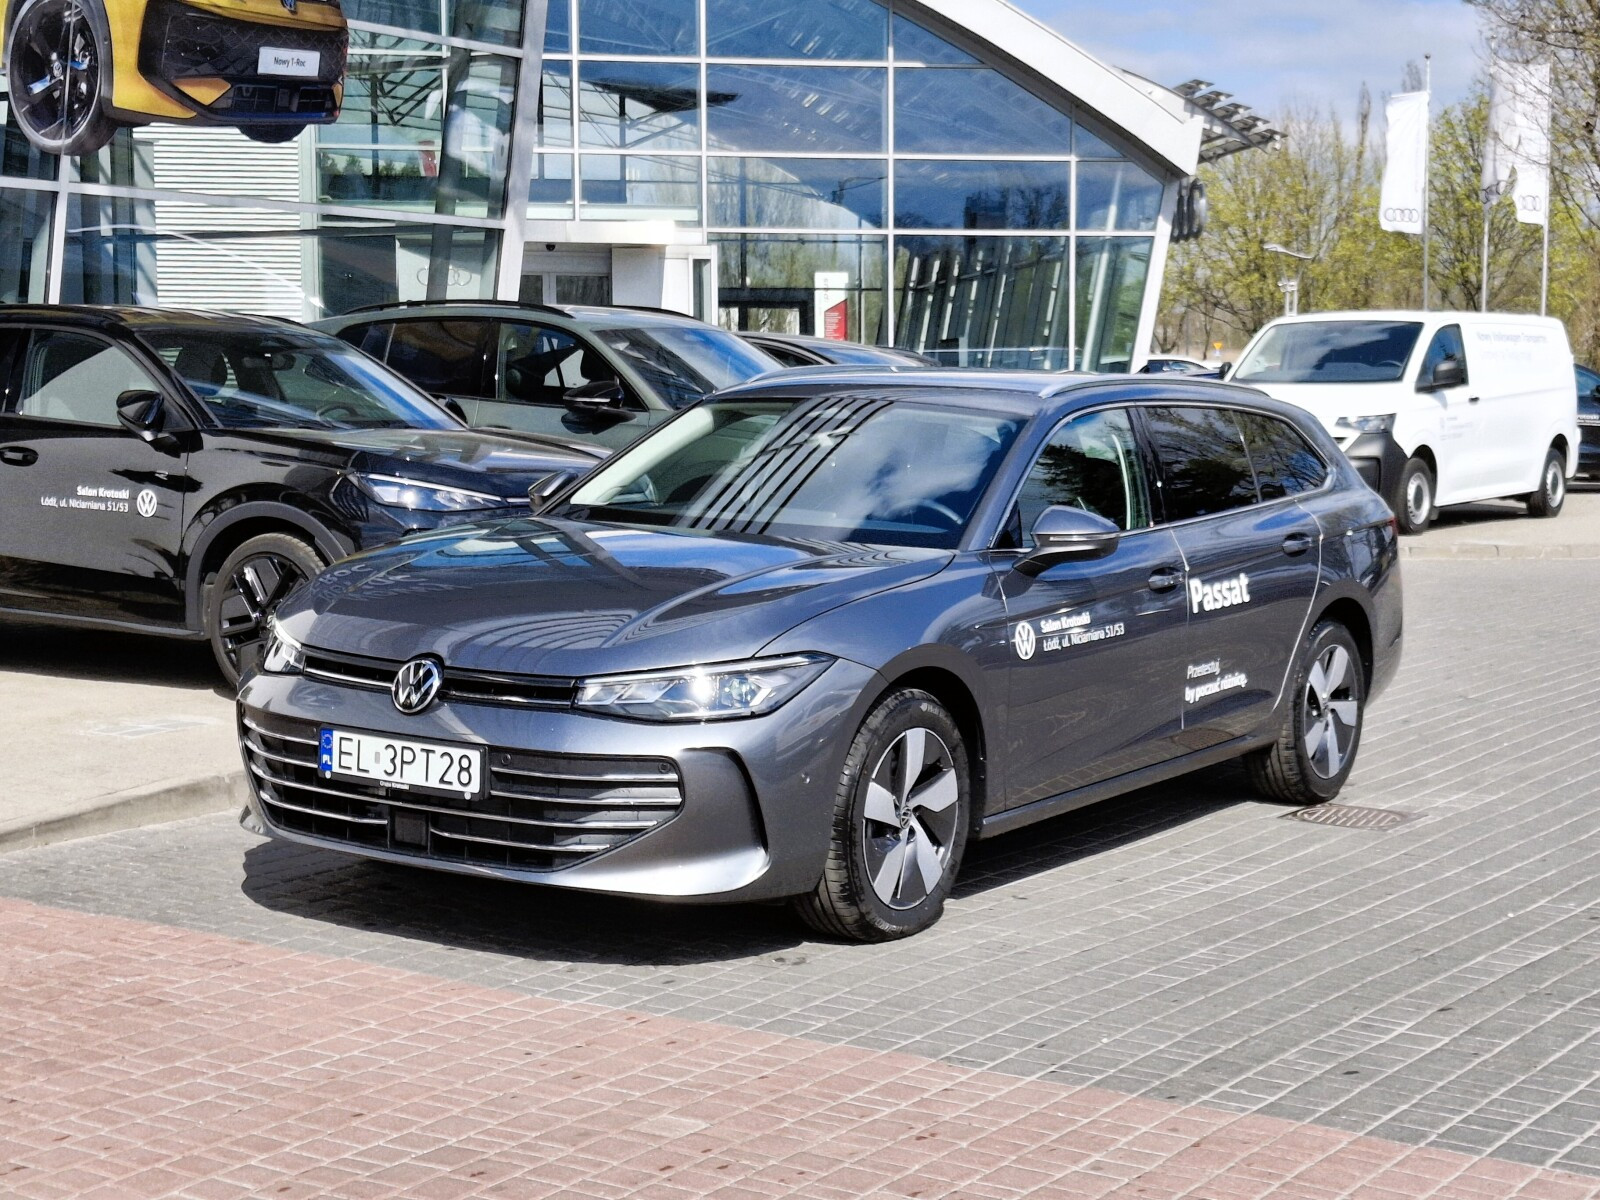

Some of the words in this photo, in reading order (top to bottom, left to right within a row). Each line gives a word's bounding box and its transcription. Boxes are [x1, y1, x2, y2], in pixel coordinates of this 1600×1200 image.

[76, 485, 98, 497] Salon
[98, 487, 130, 500] Krotoski
[59, 497, 68, 508] ul.
[106, 501, 129, 513] 51/53
[1189, 572, 1250, 614] Passat
[1040, 616, 1061, 634] Salon
[1061, 611, 1091, 629] Krotoski
[1105, 622, 1125, 638] 51/53
[322, 754, 332, 765] PL
[338, 736, 370, 774] EL
[383, 744, 473, 787] 3PT28
